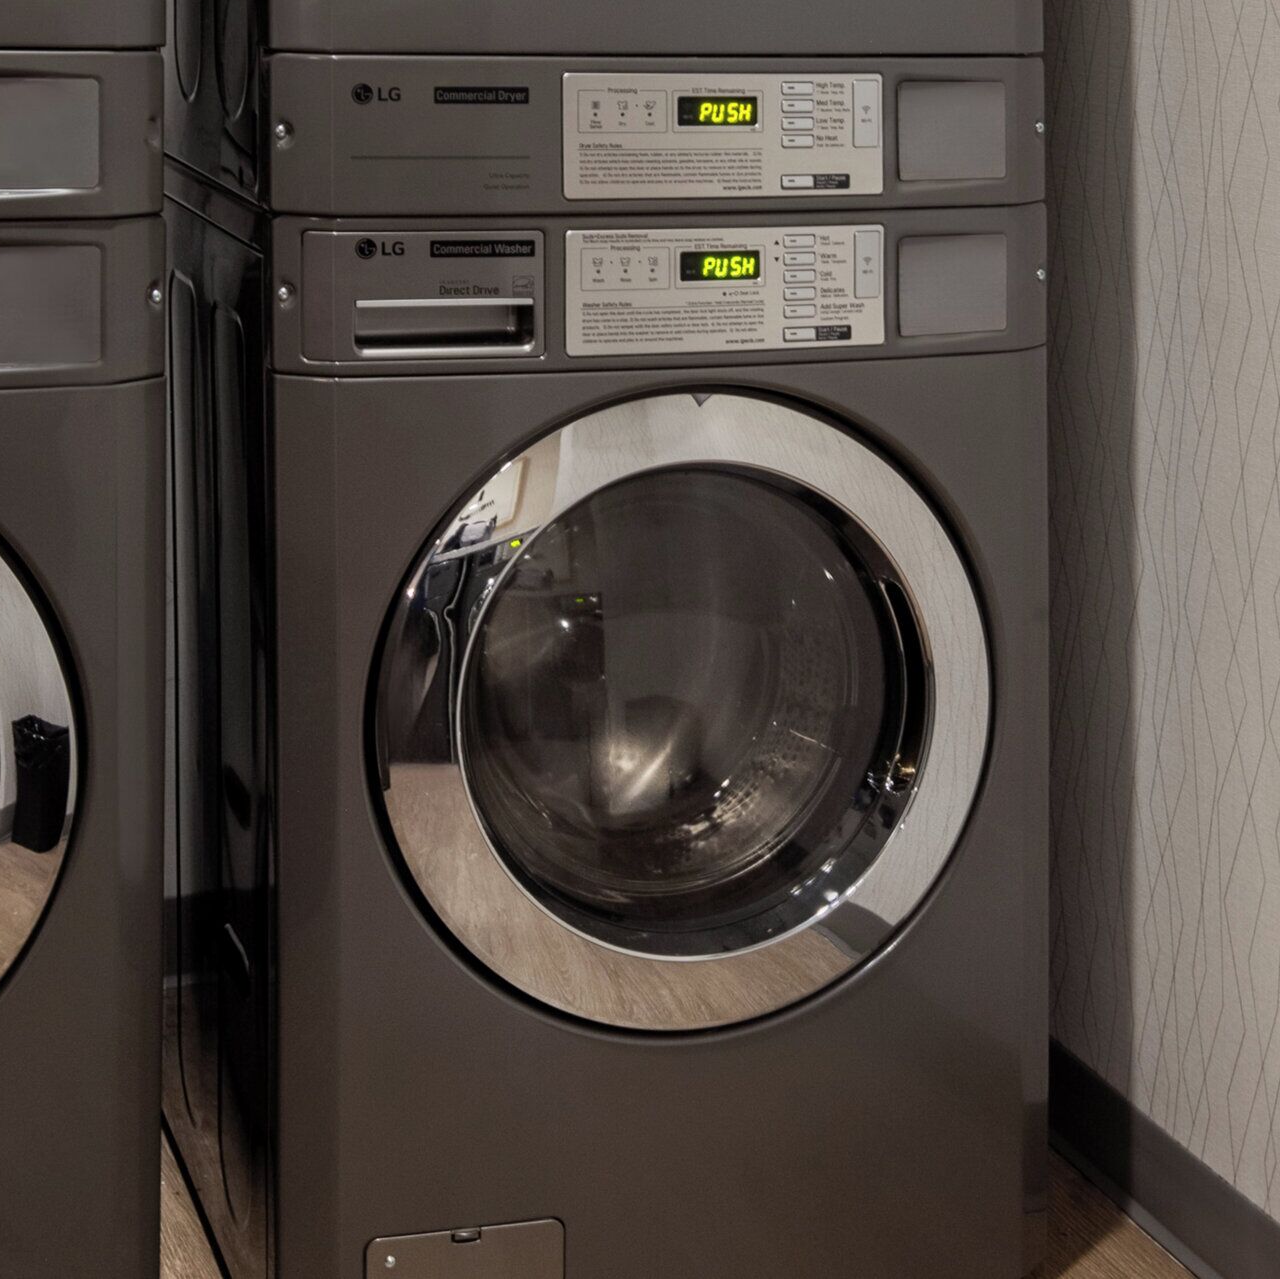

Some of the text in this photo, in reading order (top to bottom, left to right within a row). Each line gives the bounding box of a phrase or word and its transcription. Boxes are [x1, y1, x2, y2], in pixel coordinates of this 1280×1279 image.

[377, 87, 401, 101] LG
[436, 90, 526, 102] Commercial Dryer
[699, 102, 753, 123] PUSH
[381, 241, 405, 256] LG
[433, 244, 532, 255] Commercial Washer
[703, 256, 756, 278] PUSH
[439, 285, 500, 296] Direct Drive
